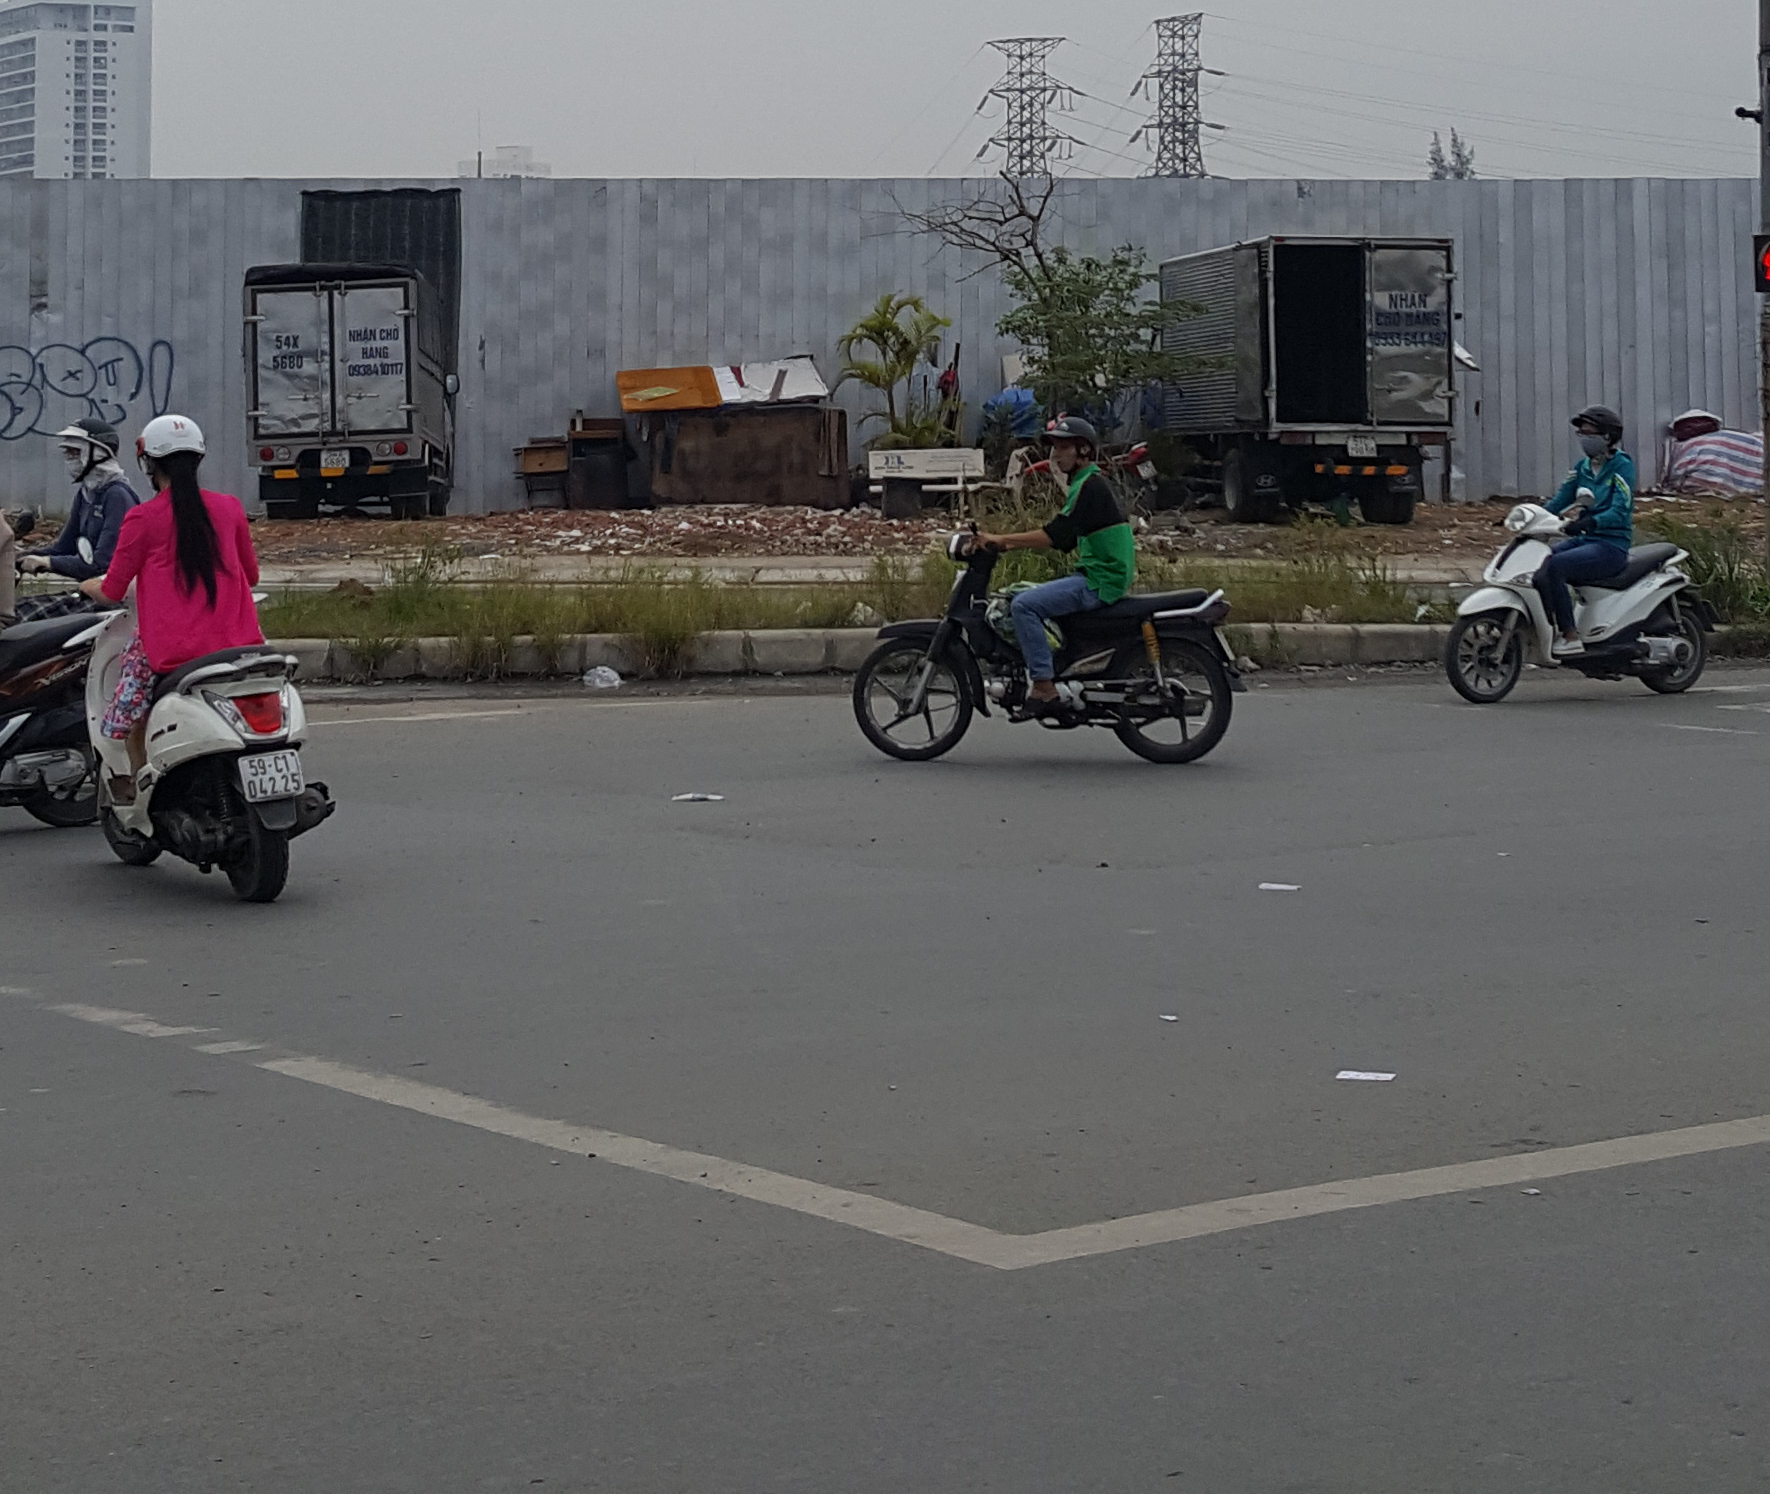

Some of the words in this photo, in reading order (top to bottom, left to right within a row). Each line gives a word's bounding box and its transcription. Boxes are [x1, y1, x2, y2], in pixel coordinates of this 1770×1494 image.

[275, 335, 300, 350] 54X
[272, 354, 304, 370] 5680
[248, 754, 290, 777] 59-C1
[247, 772, 301, 799] 042.25
